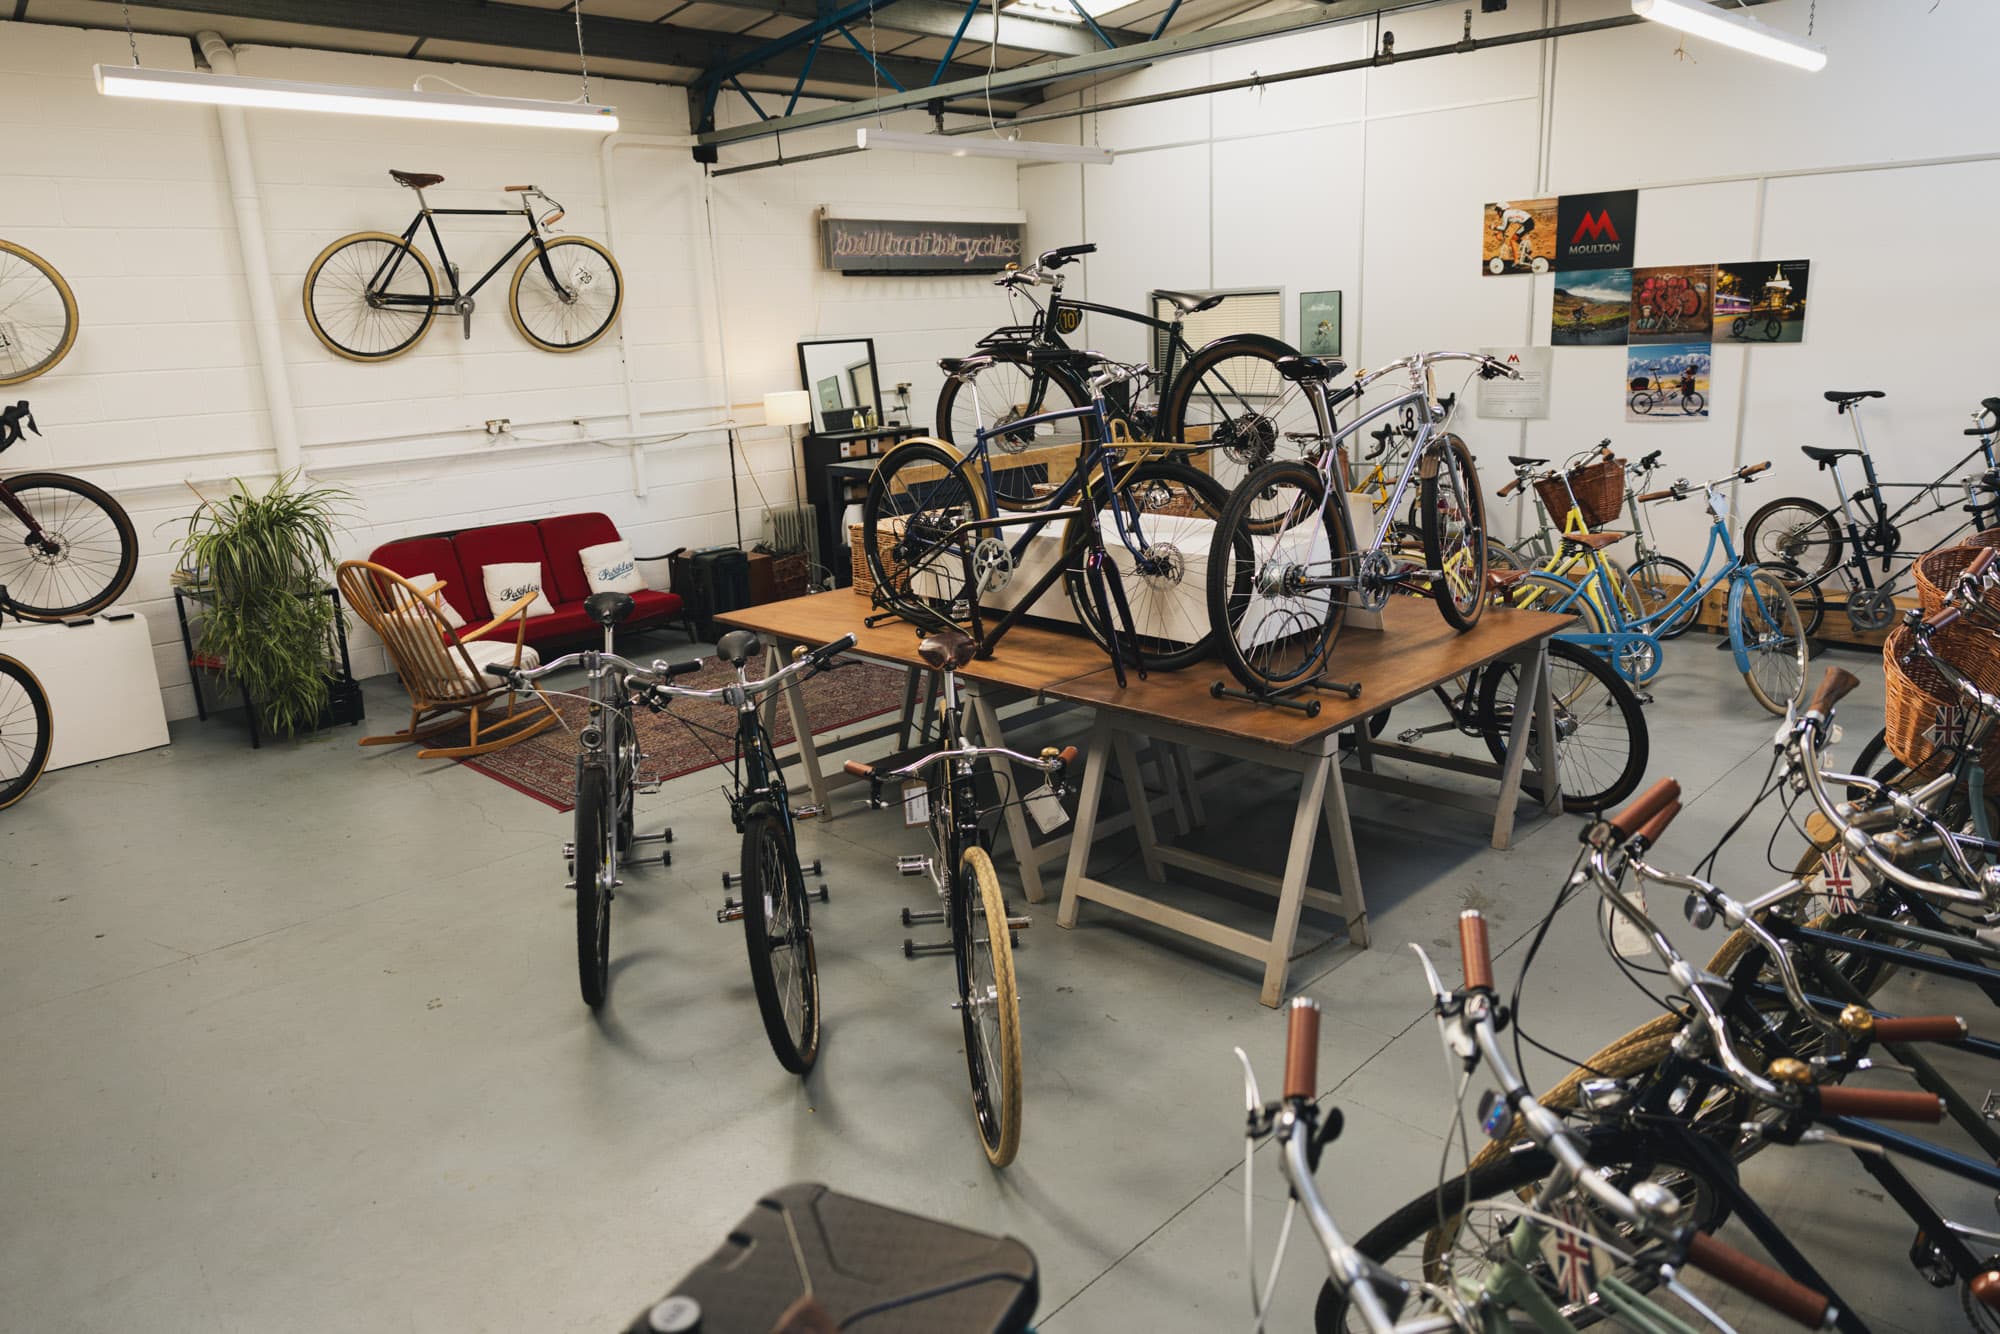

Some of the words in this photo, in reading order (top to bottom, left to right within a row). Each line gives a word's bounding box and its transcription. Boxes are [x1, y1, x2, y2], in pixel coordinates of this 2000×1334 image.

[1569, 243, 1620, 255] MOULTON
[1062, 313, 1075, 329] 10
[1405, 407, 1414, 431] 8
